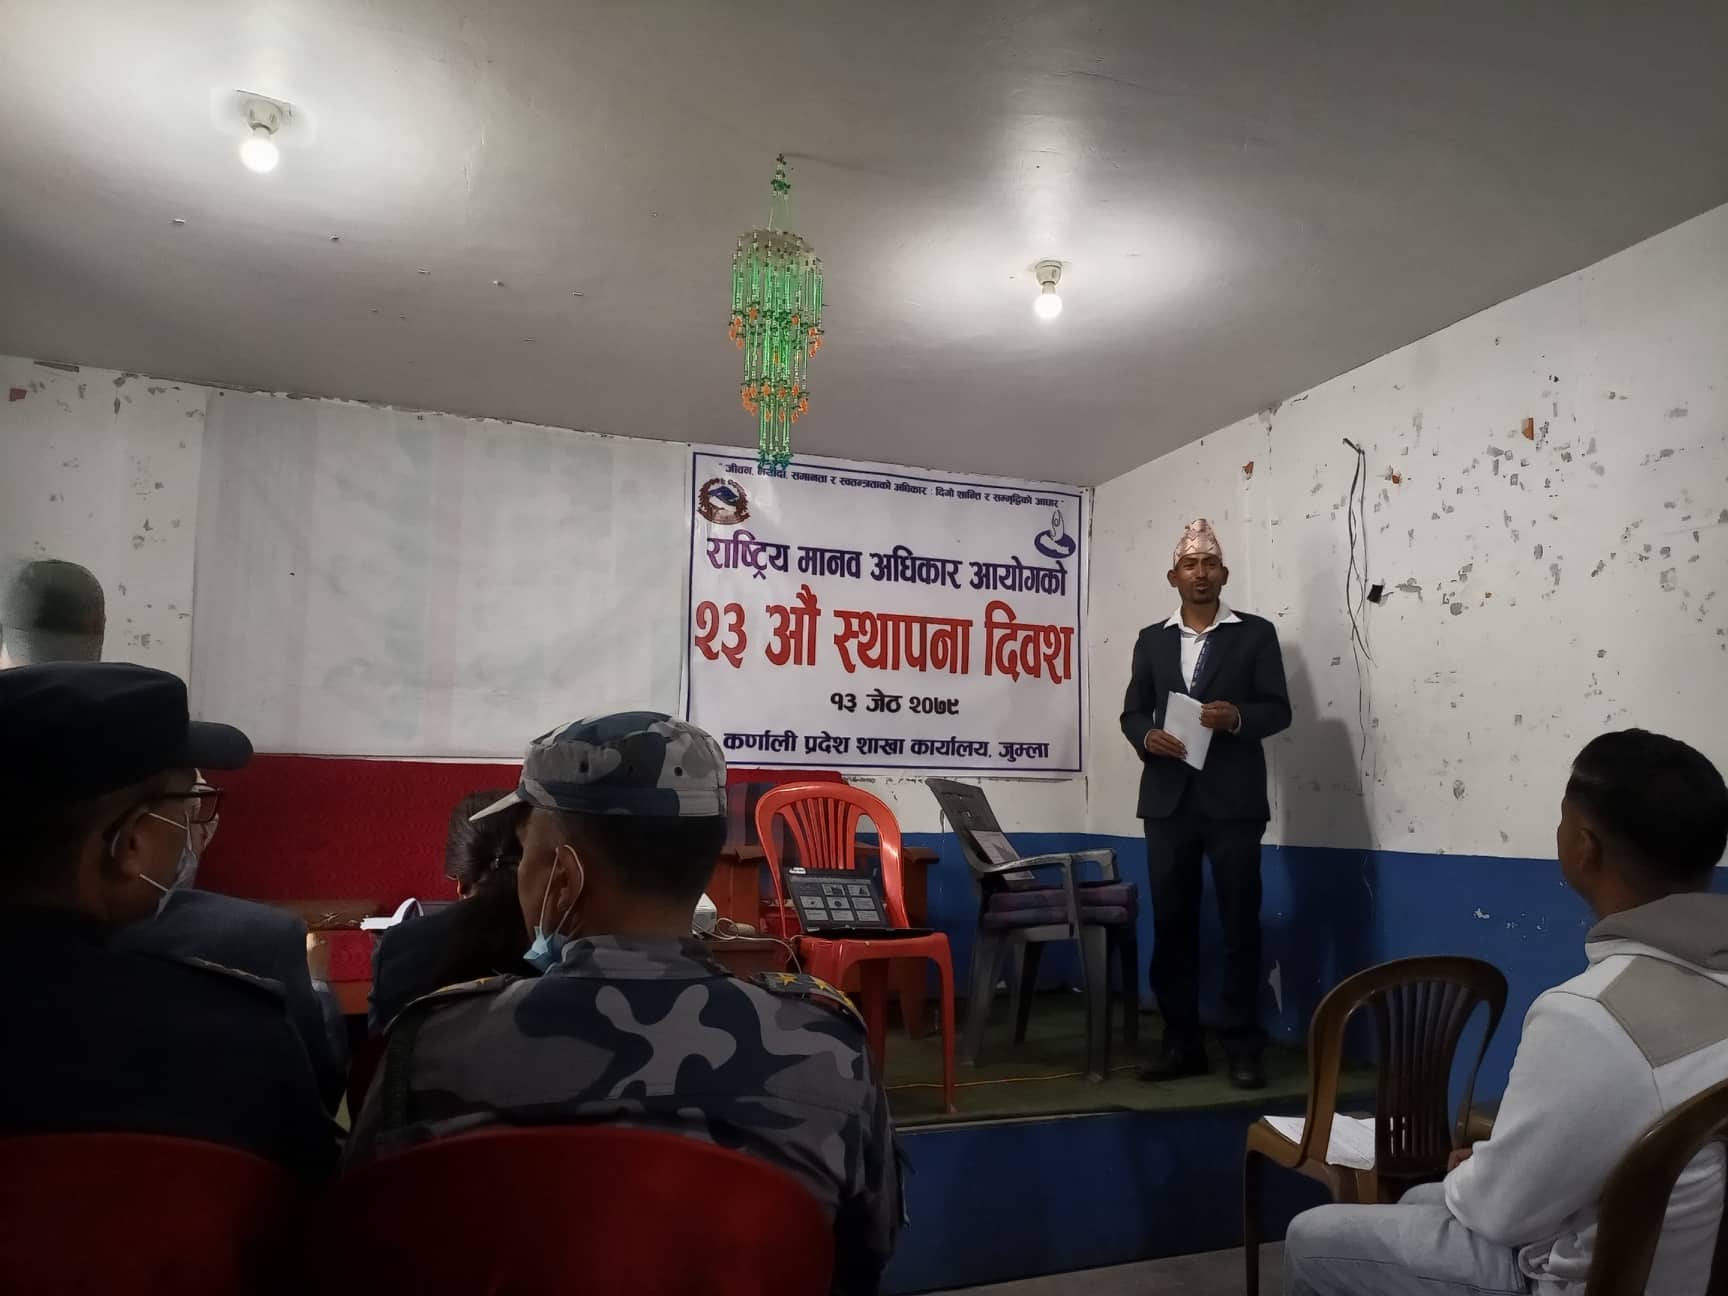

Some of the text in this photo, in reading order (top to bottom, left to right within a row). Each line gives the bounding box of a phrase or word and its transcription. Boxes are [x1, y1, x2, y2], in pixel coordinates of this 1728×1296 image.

[791, 471, 827, 483] समानता
[830, 475, 837, 485] र
[894, 482, 928, 495] अधिकार
[984, 493, 990, 501] र
[707, 530, 1068, 596] राष्ट्रिय मानव अधिकार आयोगको
[695, 601, 747, 668] २३
[834, 610, 973, 674] स्थापना
[984, 601, 1074, 684] दिवश
[831, 689, 959, 715] १३ जेठ २०७९
[723, 731, 797, 753] कर्णाली
[804, 731, 850, 754] प्रदेश
[856, 736, 905, 755] शाखा
[999, 742, 1049, 762] जुम्ला
